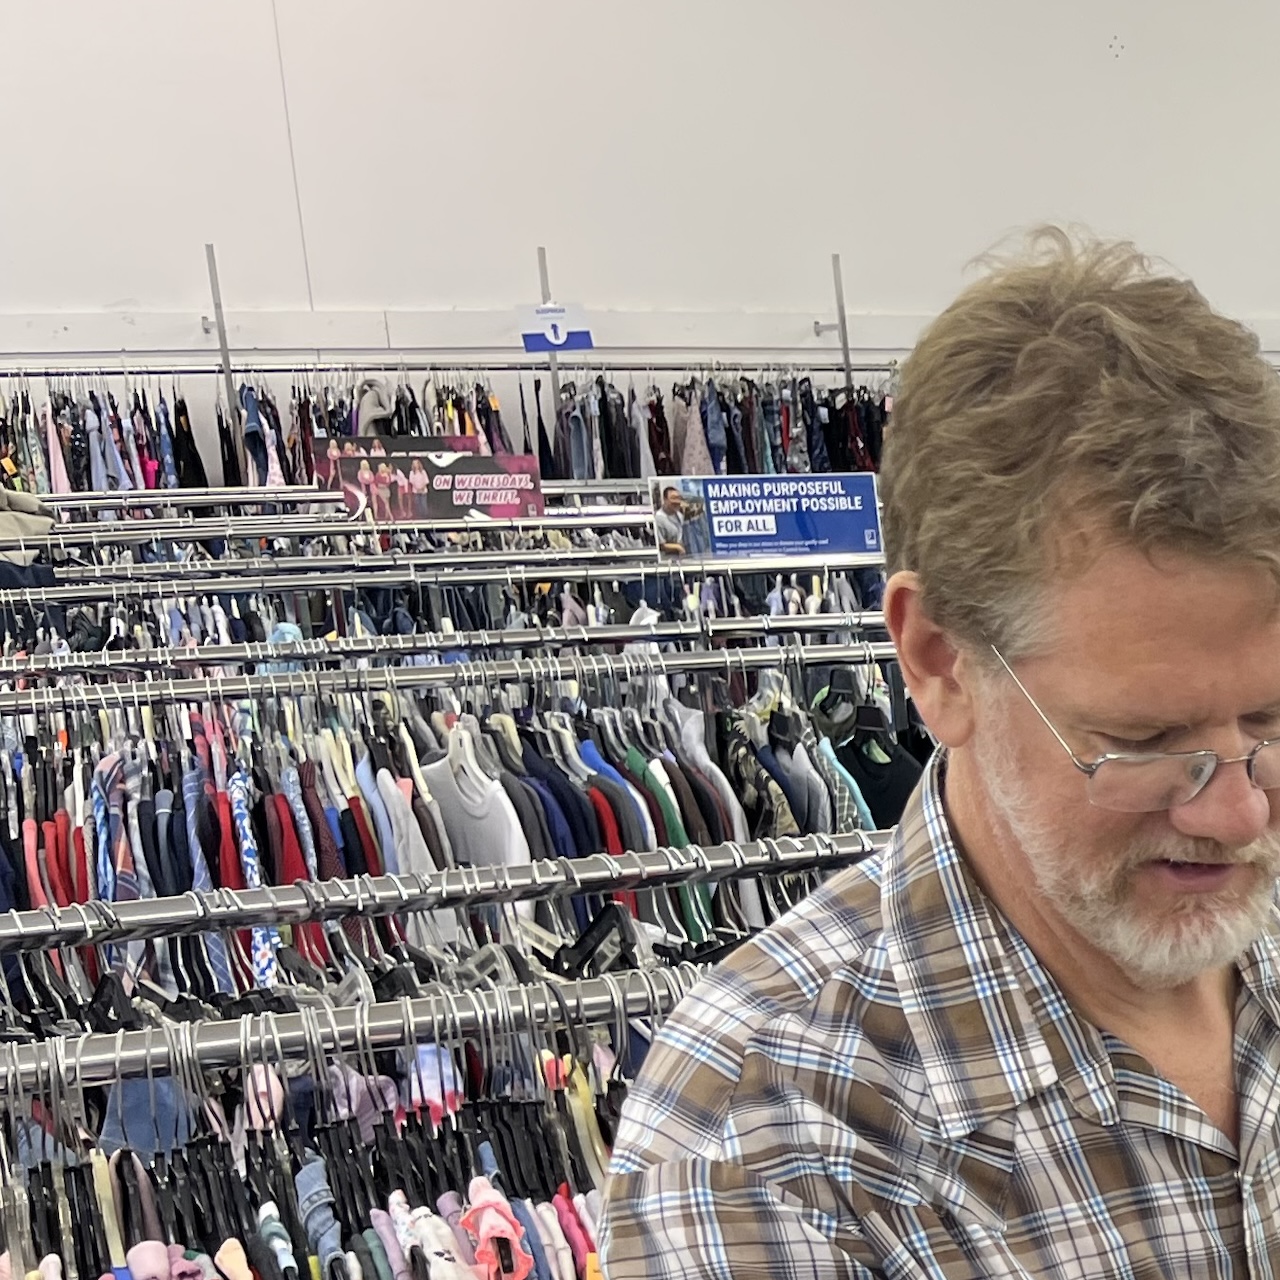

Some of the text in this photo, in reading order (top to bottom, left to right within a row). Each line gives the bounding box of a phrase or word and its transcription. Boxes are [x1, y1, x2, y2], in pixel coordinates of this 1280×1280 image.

[433, 475, 452, 490] ON
[707, 481, 846, 499] MAKING PURPOSEFUL
[453, 490, 474, 505] WE
[709, 496, 863, 515] EMPLOYMENT POSSIBLE
[717, 518, 775, 534] FOR ALL.
